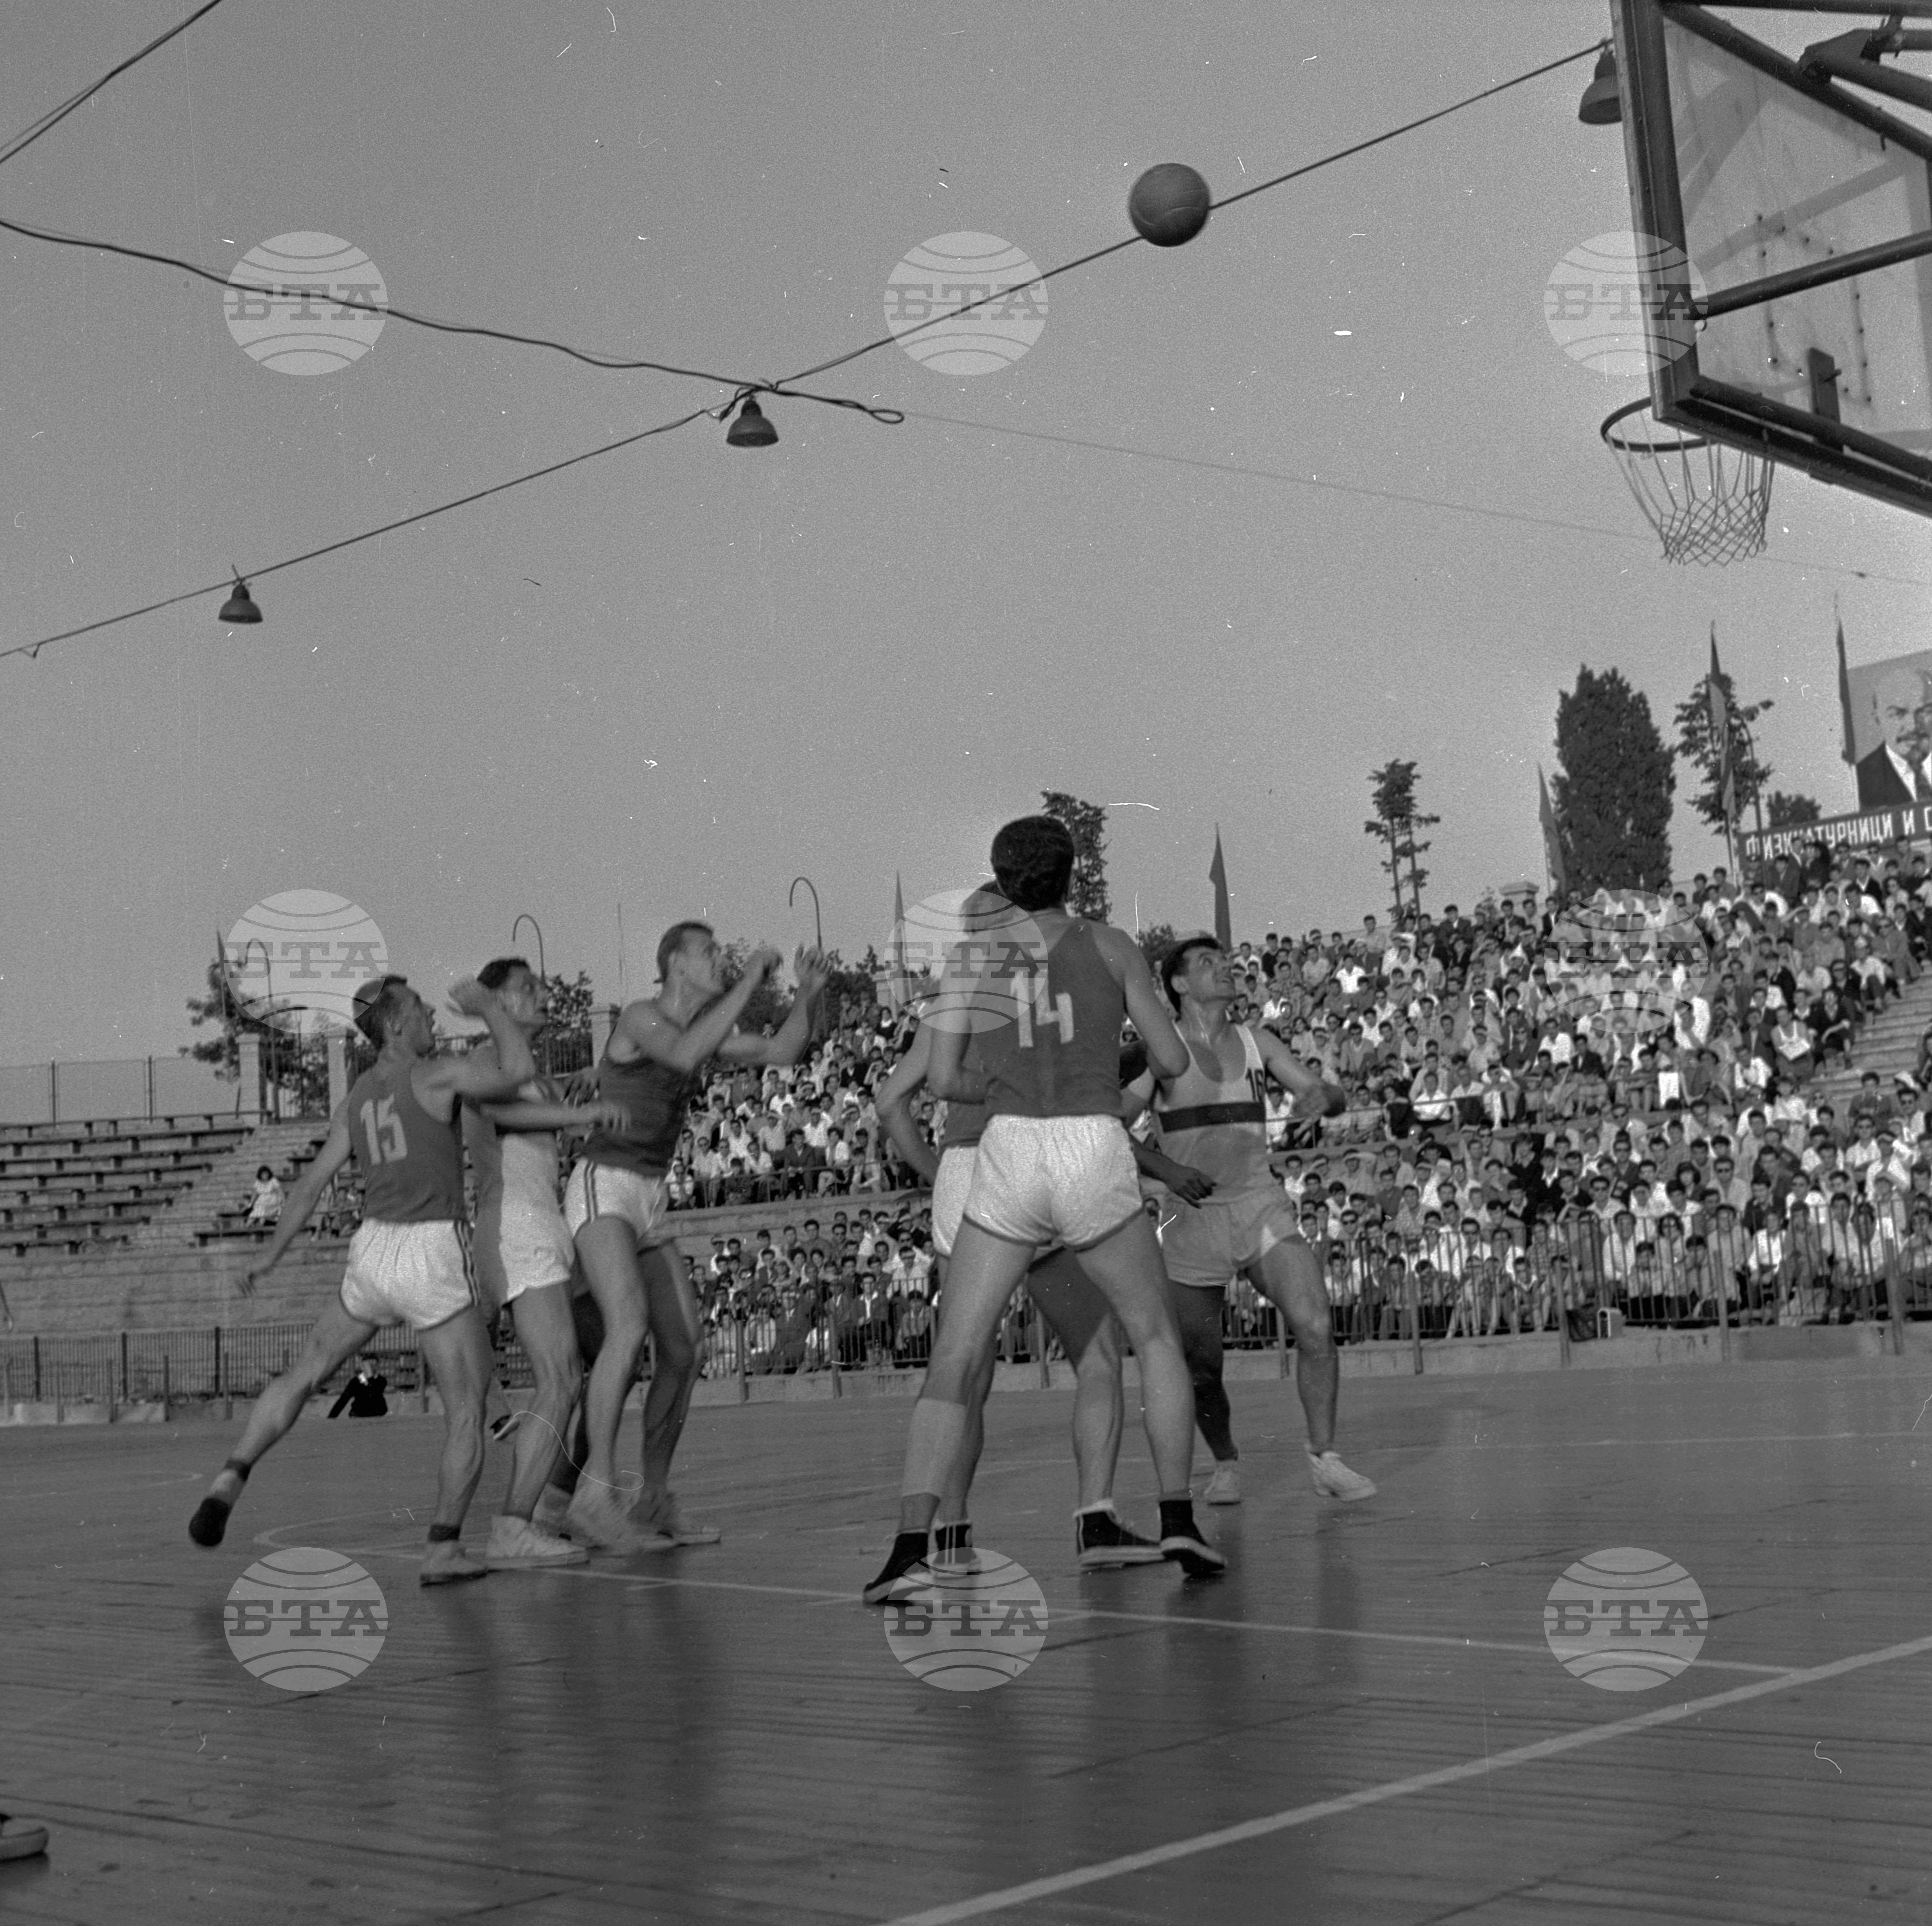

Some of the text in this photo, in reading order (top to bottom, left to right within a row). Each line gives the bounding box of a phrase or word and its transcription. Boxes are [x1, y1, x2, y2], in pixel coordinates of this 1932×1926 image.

[1746, 813, 1893, 861] ФИЗКЛТУРНИЦИ
[1903, 809, 1915, 835] И
[1010, 970, 1074, 1047] 14
[360, 1094, 407, 1165] 15
